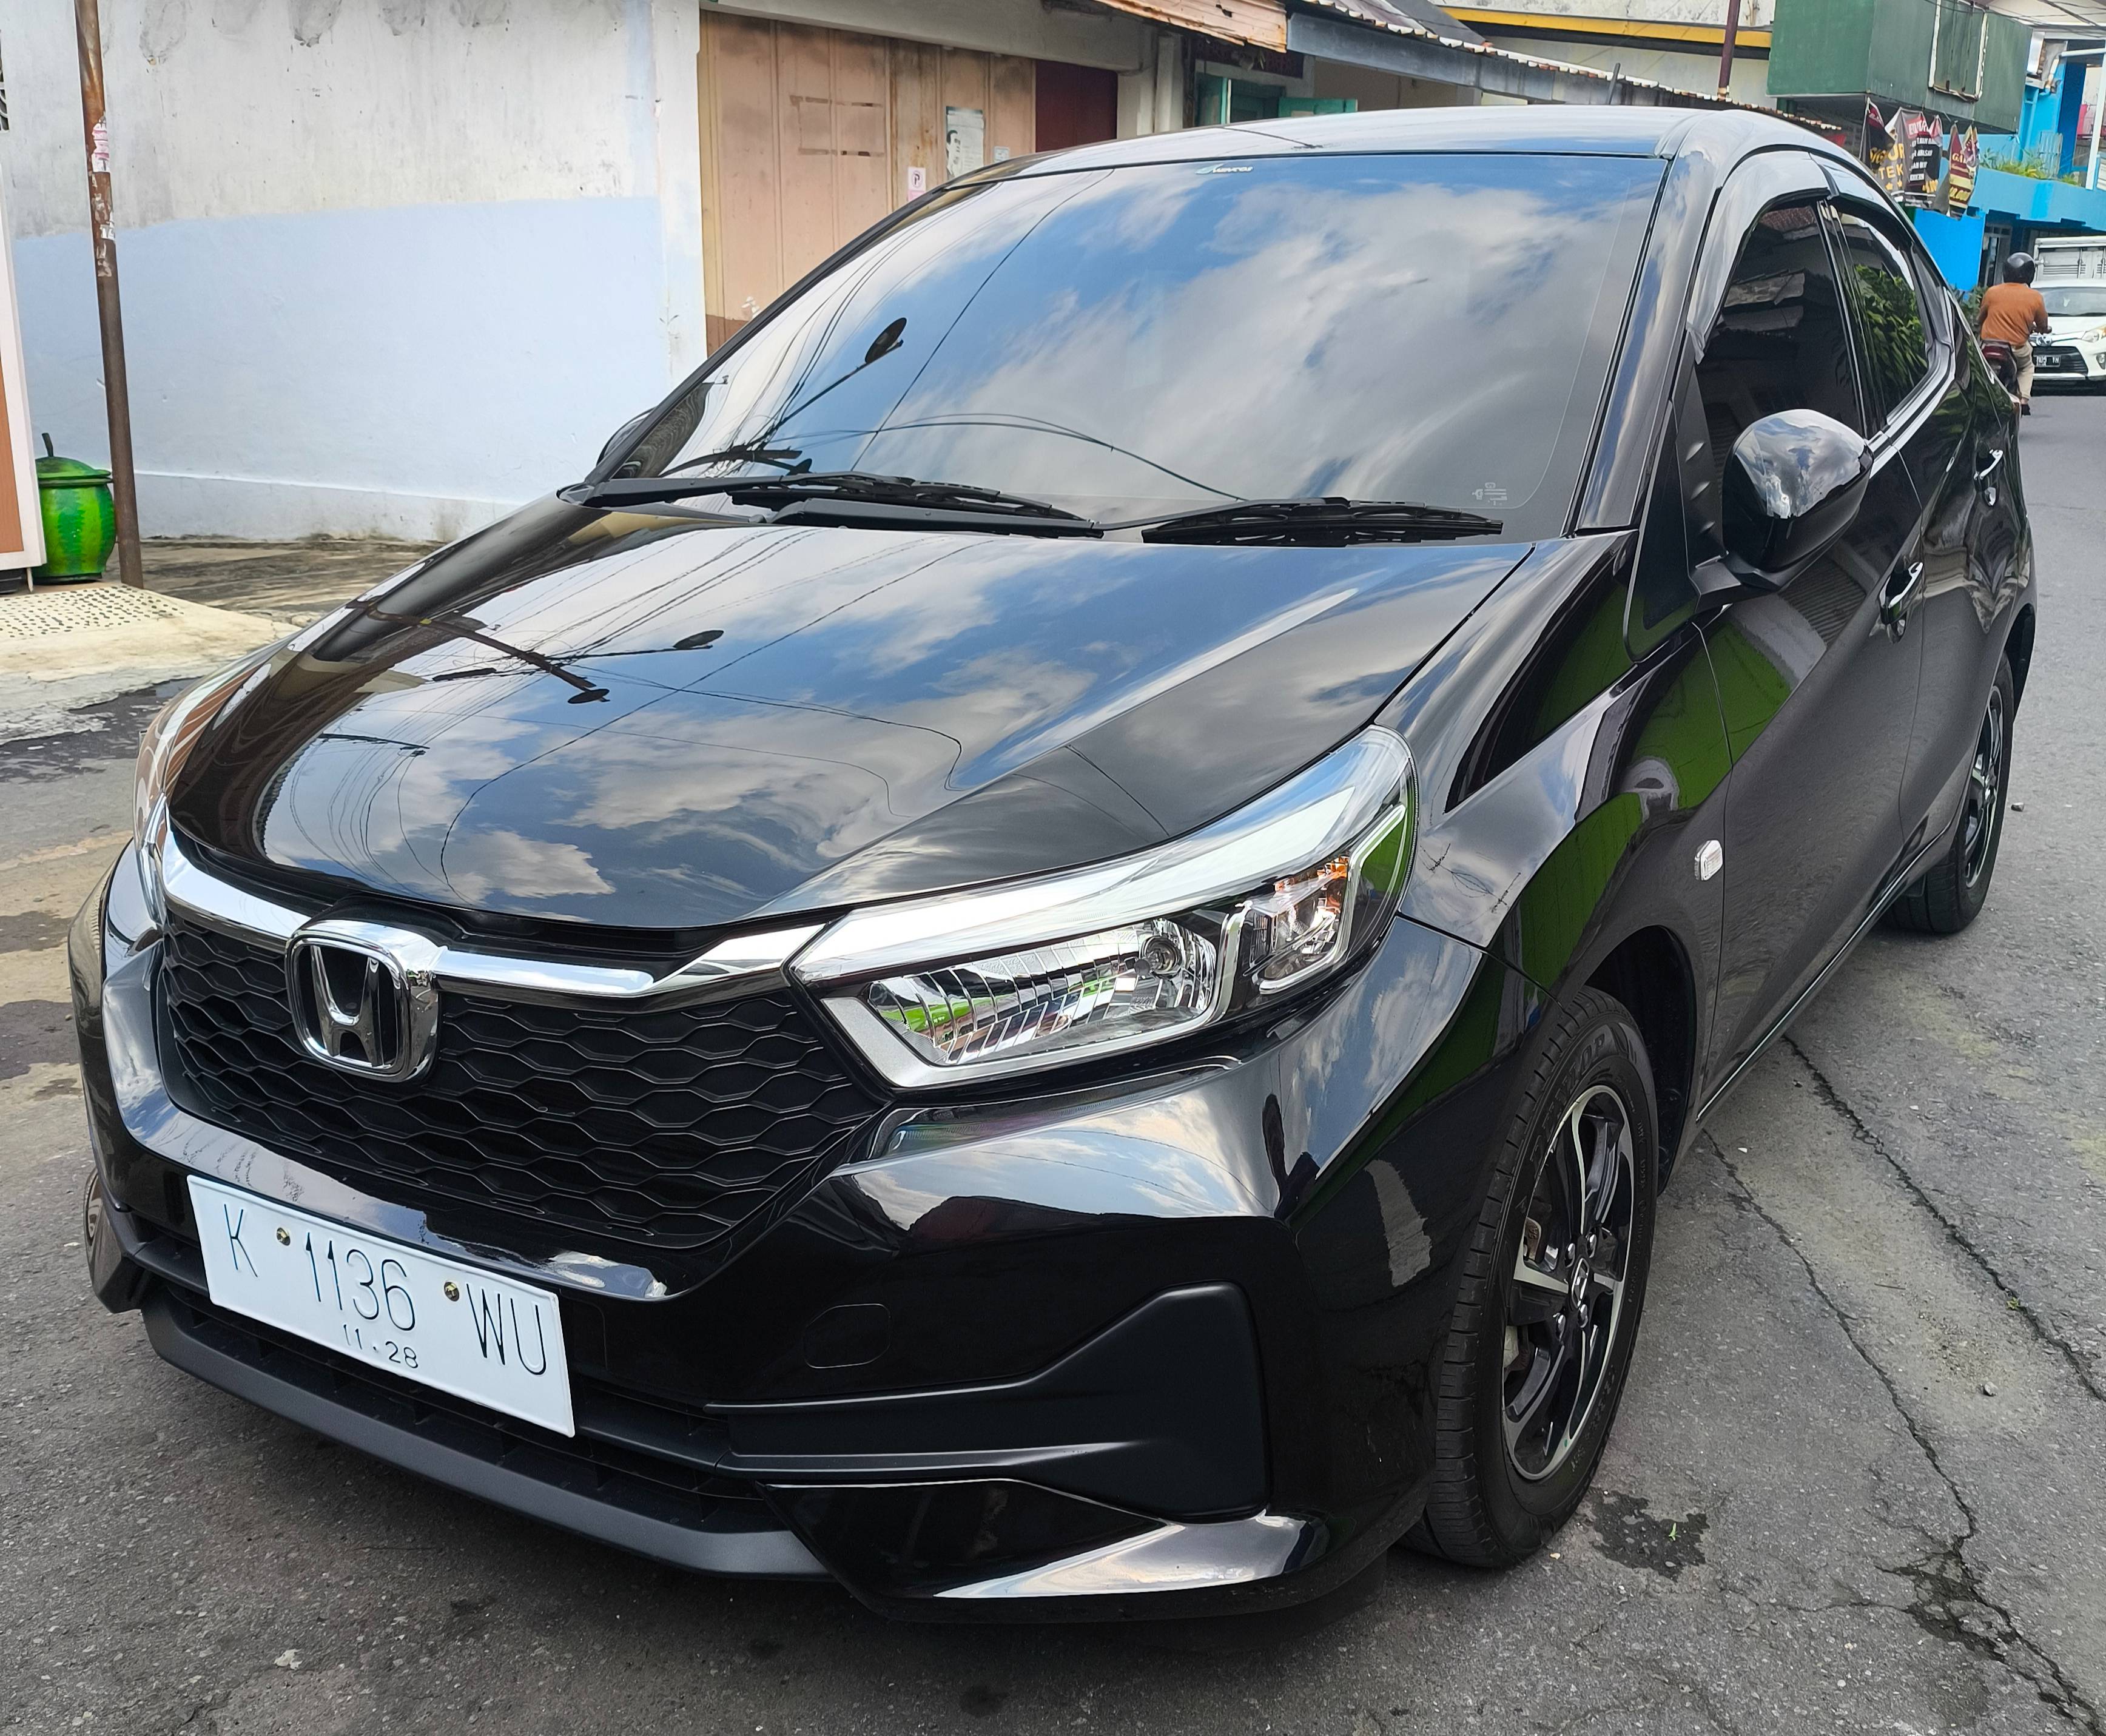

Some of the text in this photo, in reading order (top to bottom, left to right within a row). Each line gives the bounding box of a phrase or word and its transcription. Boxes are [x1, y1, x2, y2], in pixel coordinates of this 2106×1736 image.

[224, 1203, 547, 1376] K 1136 WU
